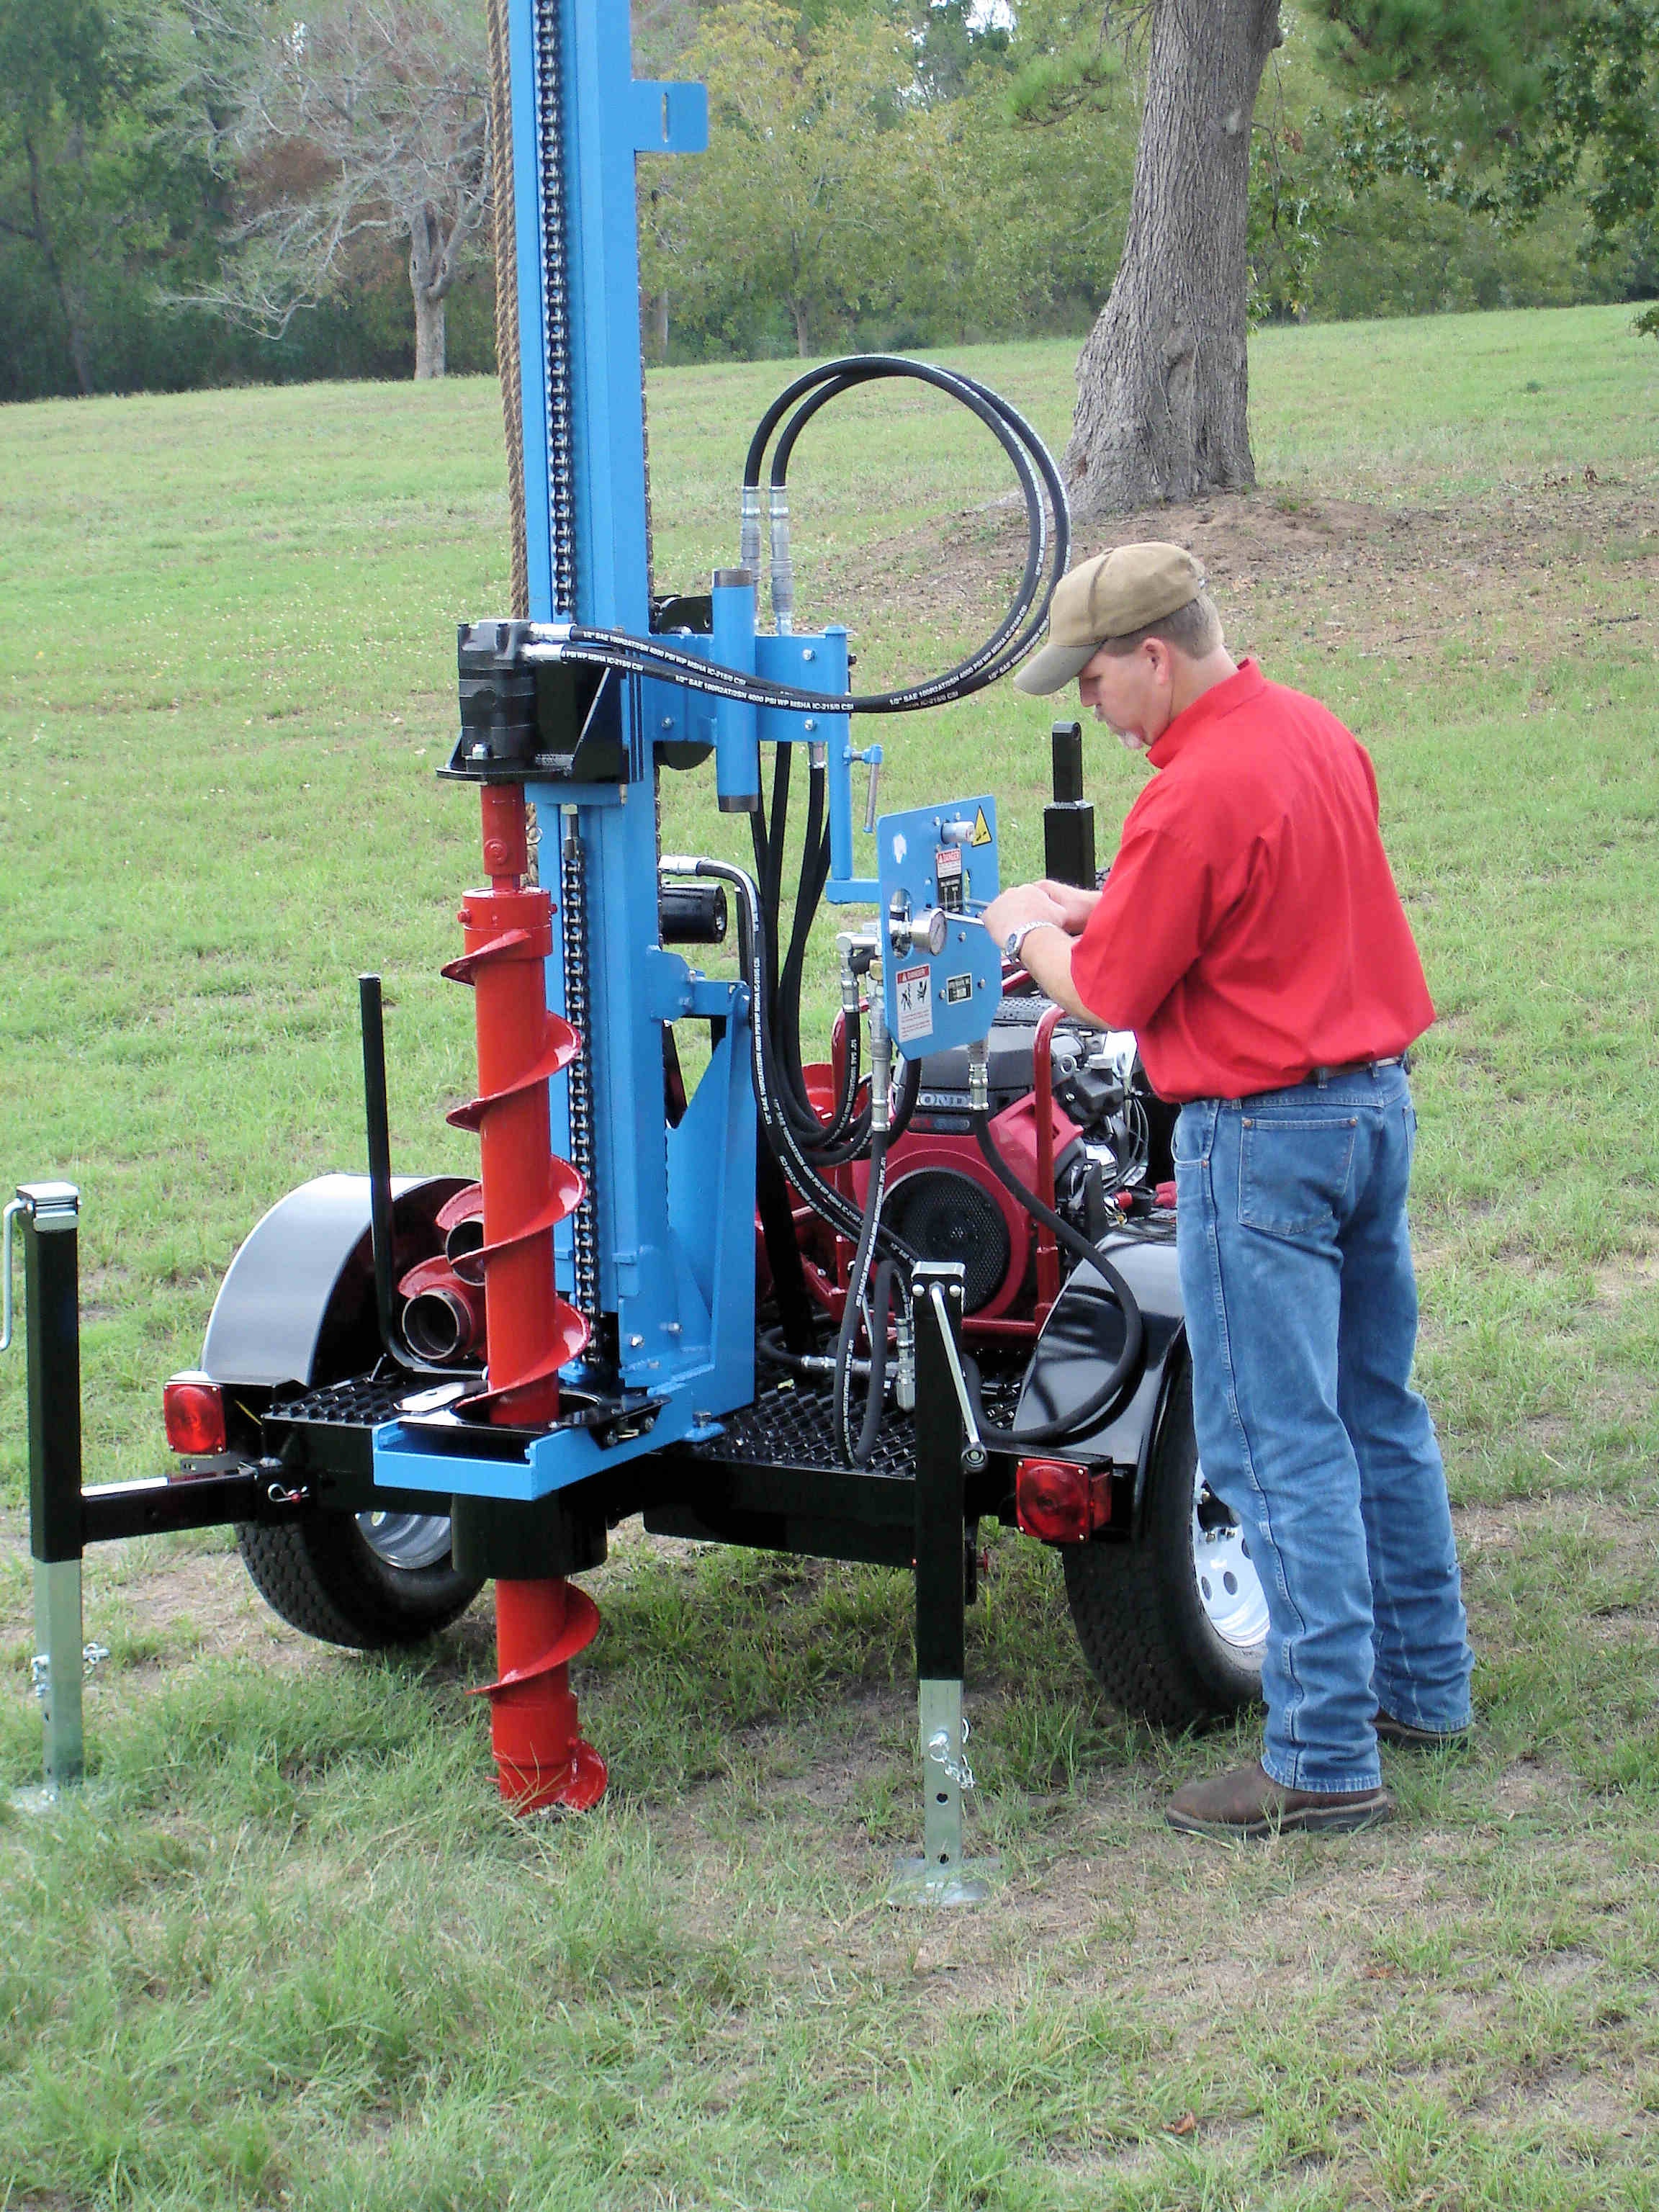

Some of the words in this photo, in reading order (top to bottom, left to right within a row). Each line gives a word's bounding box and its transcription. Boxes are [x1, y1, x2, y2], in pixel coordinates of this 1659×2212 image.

[595, 632, 609, 642] SAE
[688, 678, 703, 688] SAE
[765, 696, 776, 705] PSI
[790, 701, 811, 710] MSHA
[916, 1093, 970, 1107] OND
